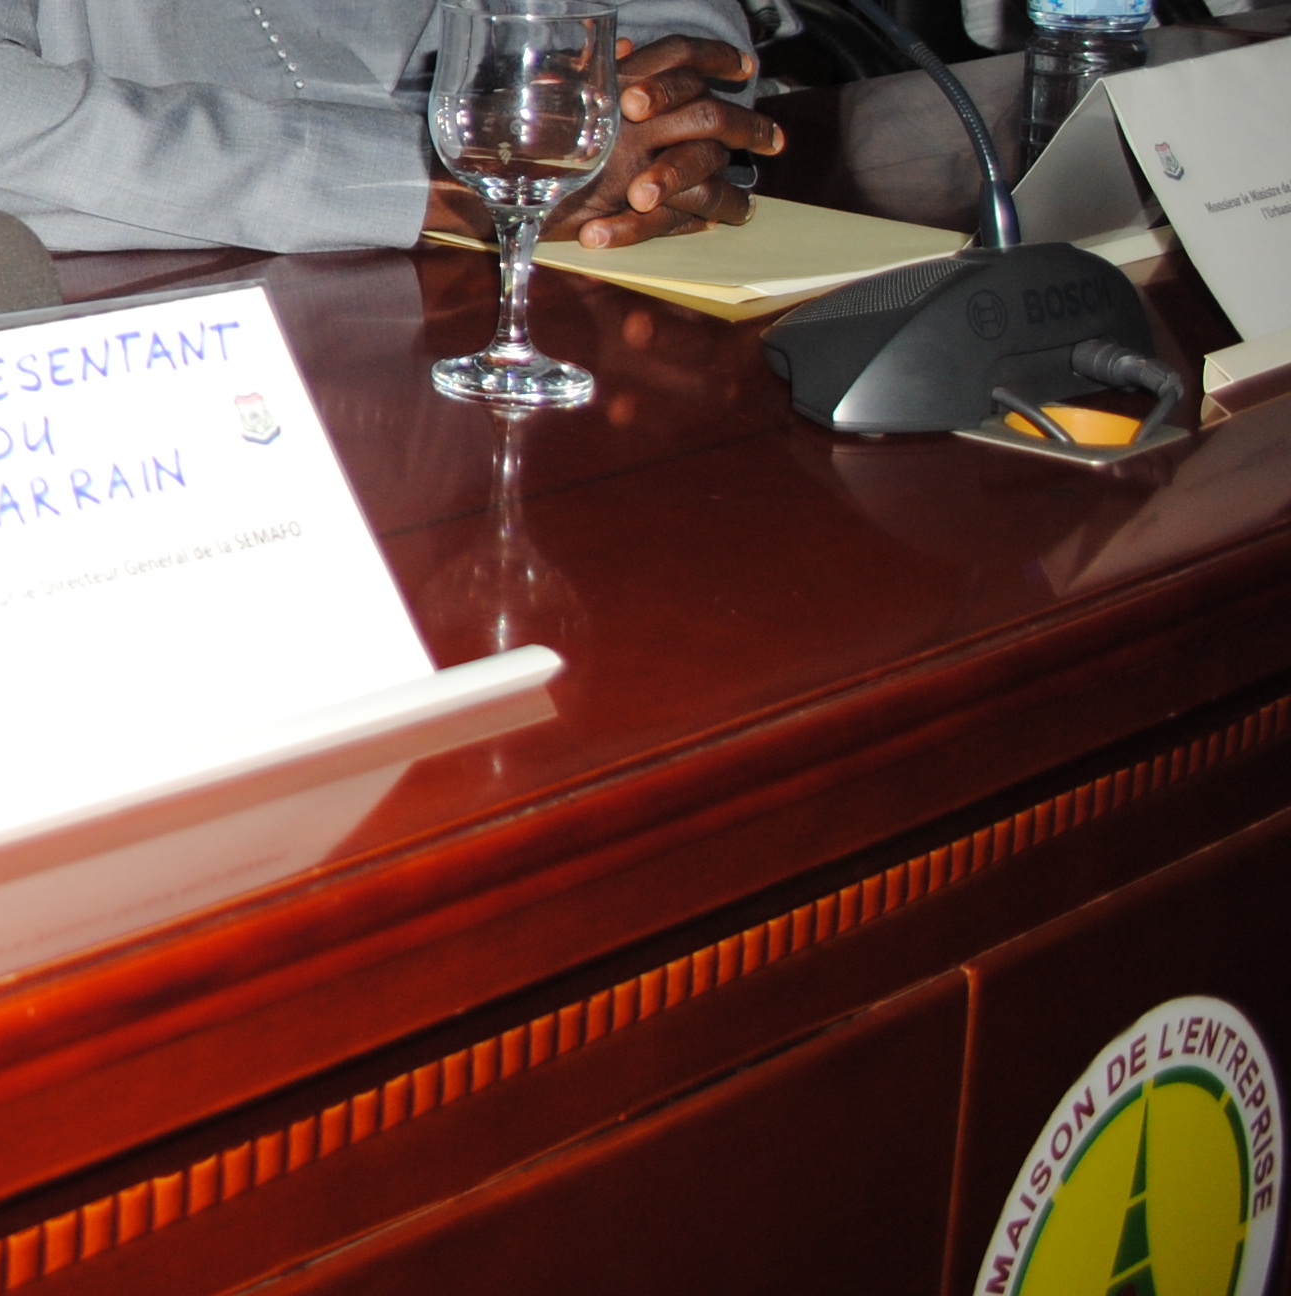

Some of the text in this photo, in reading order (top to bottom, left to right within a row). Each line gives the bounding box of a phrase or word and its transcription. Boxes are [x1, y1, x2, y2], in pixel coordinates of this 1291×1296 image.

[1022, 277, 1113, 325] BOSCH
[233, 520, 303, 551] SEMAFO
[985, 1016, 1275, 1294] MAISON DE L'ENTREPRISE
